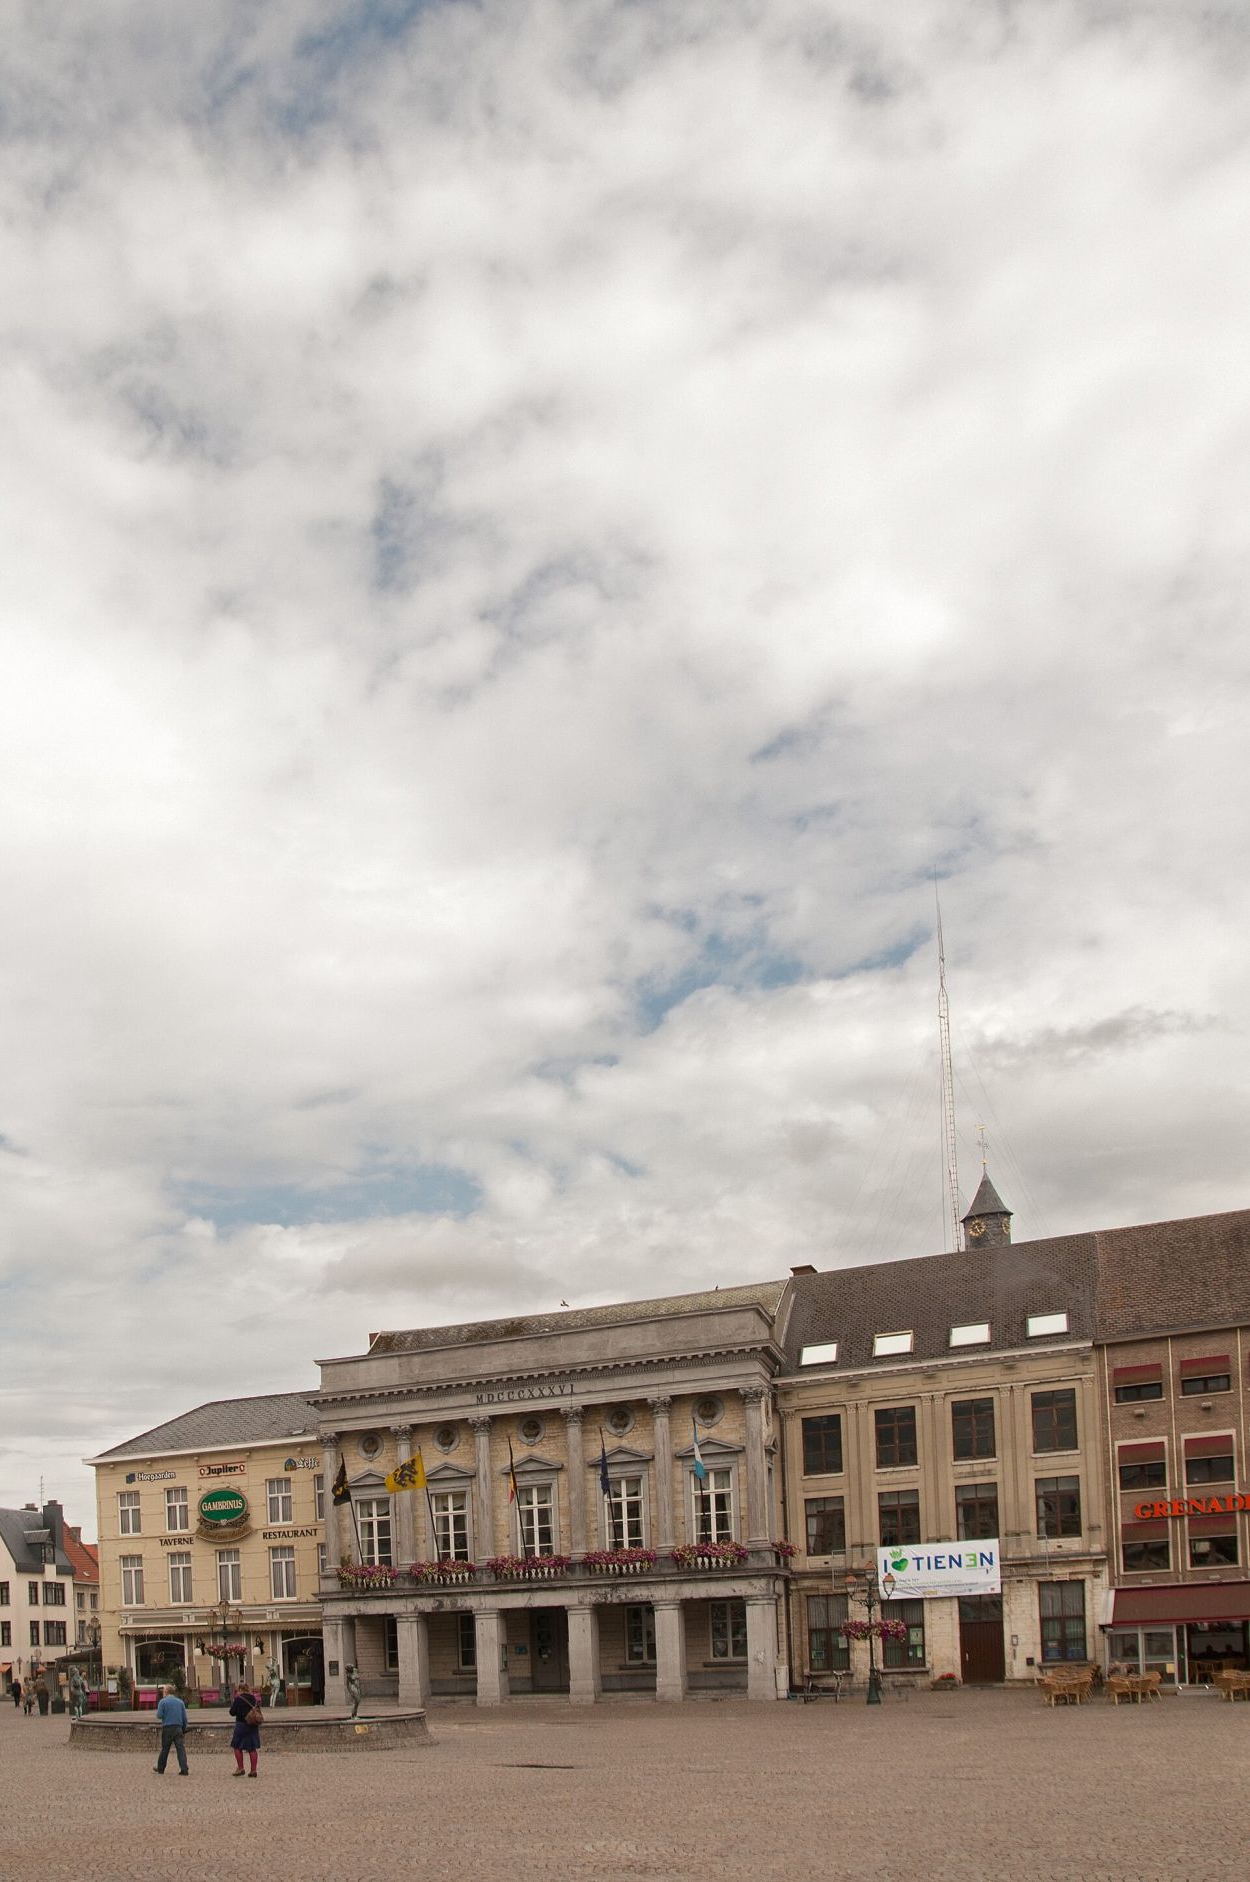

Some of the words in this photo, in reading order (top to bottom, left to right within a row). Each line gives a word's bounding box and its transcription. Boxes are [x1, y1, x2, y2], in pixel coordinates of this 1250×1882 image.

[476, 1384, 574, 1404] MDCCCXXXVI
[296, 1456, 320, 1470] Leffe
[206, 1464, 239, 1475] Jupiler
[138, 1471, 176, 1482] Hoegaarden
[201, 1499, 243, 1512] GAMBRINUS
[262, 1528, 318, 1540] RESTAURANT
[159, 1537, 194, 1547] TAVERNE
